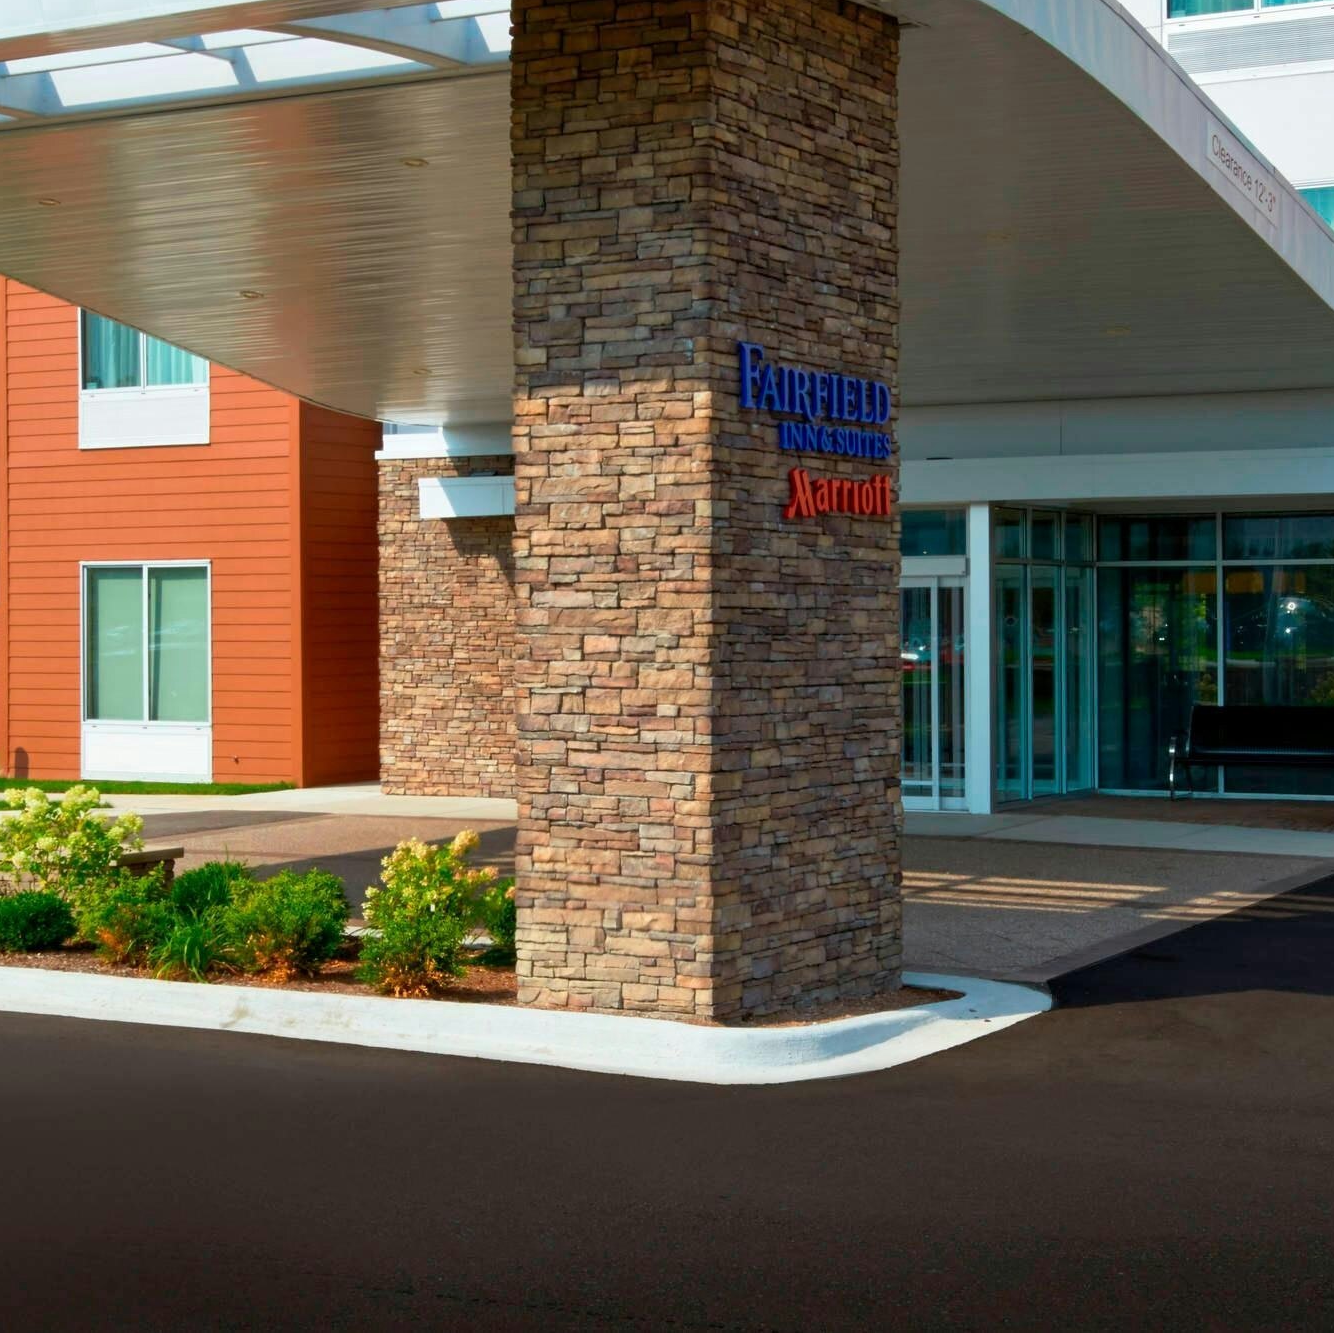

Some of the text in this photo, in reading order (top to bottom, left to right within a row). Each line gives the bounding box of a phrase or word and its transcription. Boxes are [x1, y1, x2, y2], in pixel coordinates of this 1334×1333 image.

[1211, 134, 1253, 191] Clearance
[739, 342, 891, 424] FAIRFIELD
[779, 422, 816, 451] INN
[836, 428, 891, 458] SUITES
[783, 467, 891, 519] Marriott
